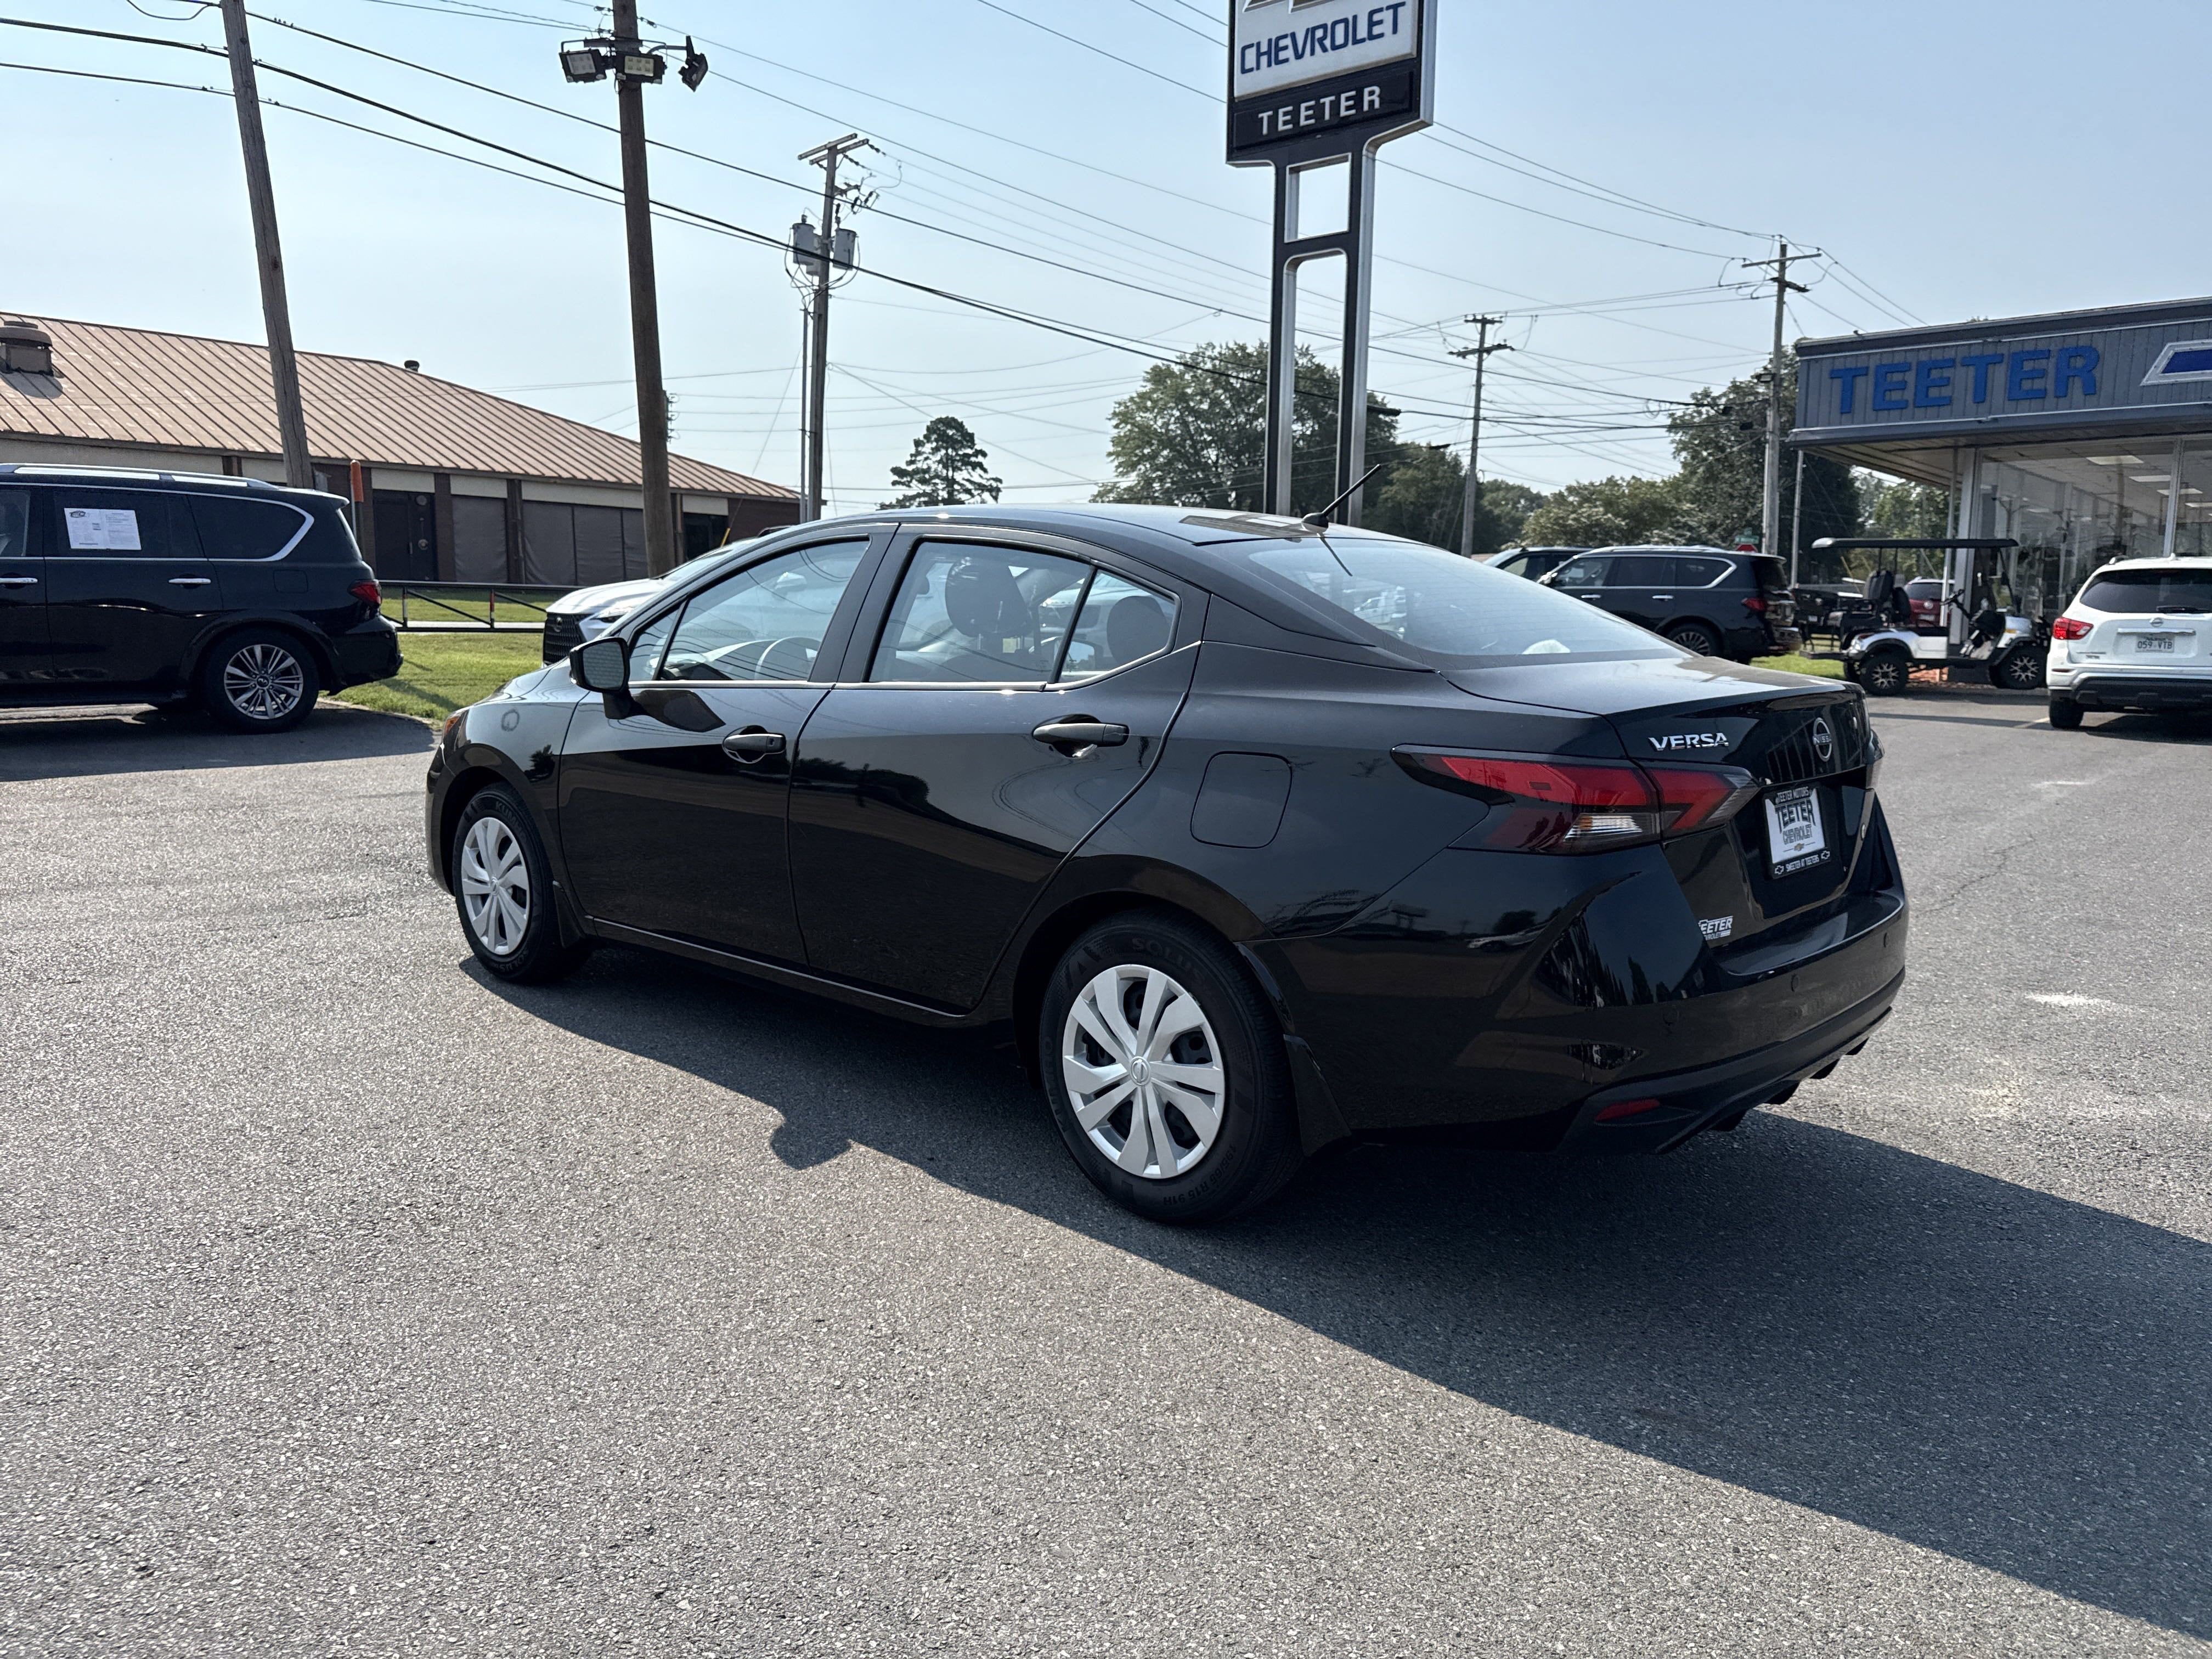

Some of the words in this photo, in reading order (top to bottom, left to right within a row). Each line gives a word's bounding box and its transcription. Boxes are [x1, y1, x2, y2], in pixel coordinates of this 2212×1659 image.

[1241, 2, 1406, 74] CHEVROLET
[1259, 86, 1380, 136] TEETER
[1830, 345, 2100, 414] TEETER
[1648, 732, 1729, 751] VERSA
[1774, 797, 1816, 834] TEETER
[1782, 823, 1813, 845] CHEVROLET
[1698, 918, 1733, 934] EETER
